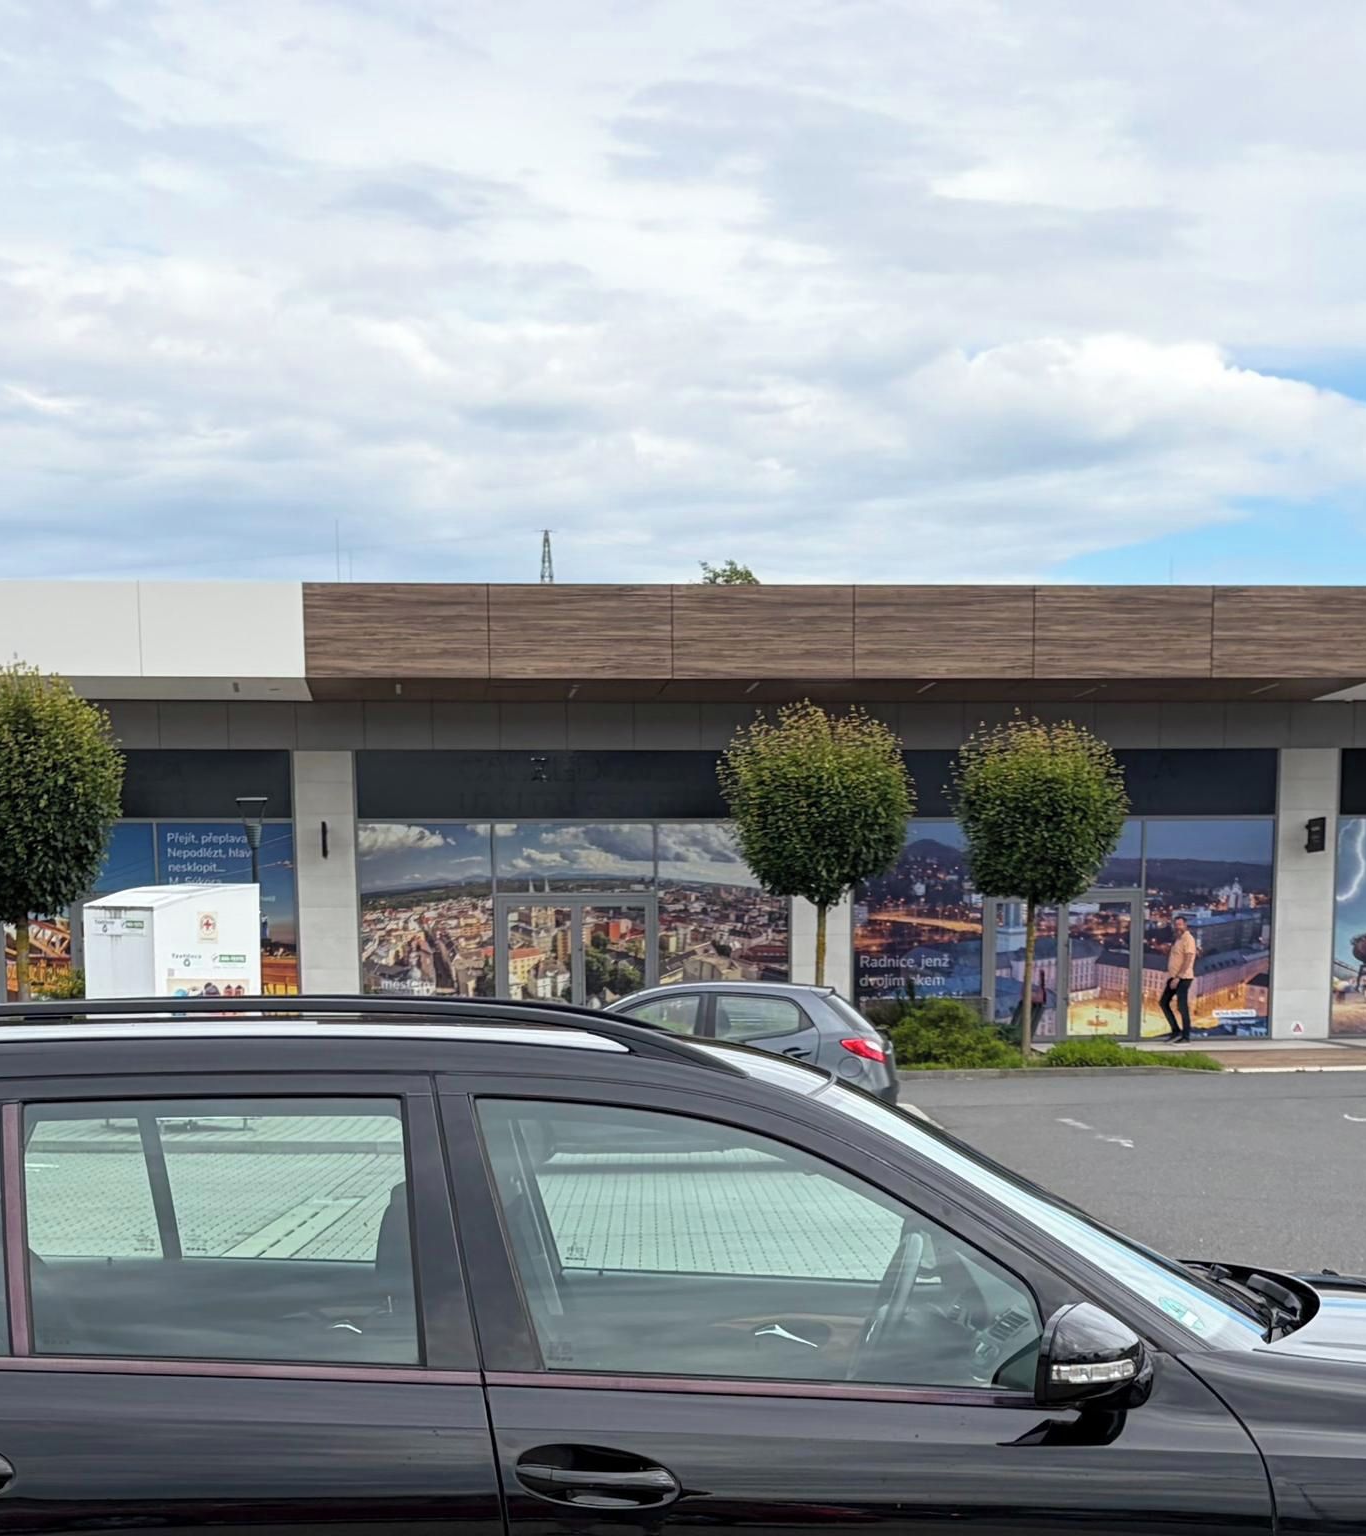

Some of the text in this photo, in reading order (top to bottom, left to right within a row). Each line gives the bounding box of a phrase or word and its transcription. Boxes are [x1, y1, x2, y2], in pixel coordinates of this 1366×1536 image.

[201, 832, 248, 846] přeplava
[228, 847, 253, 858] hlav
[919, 953, 951, 970] jenž
